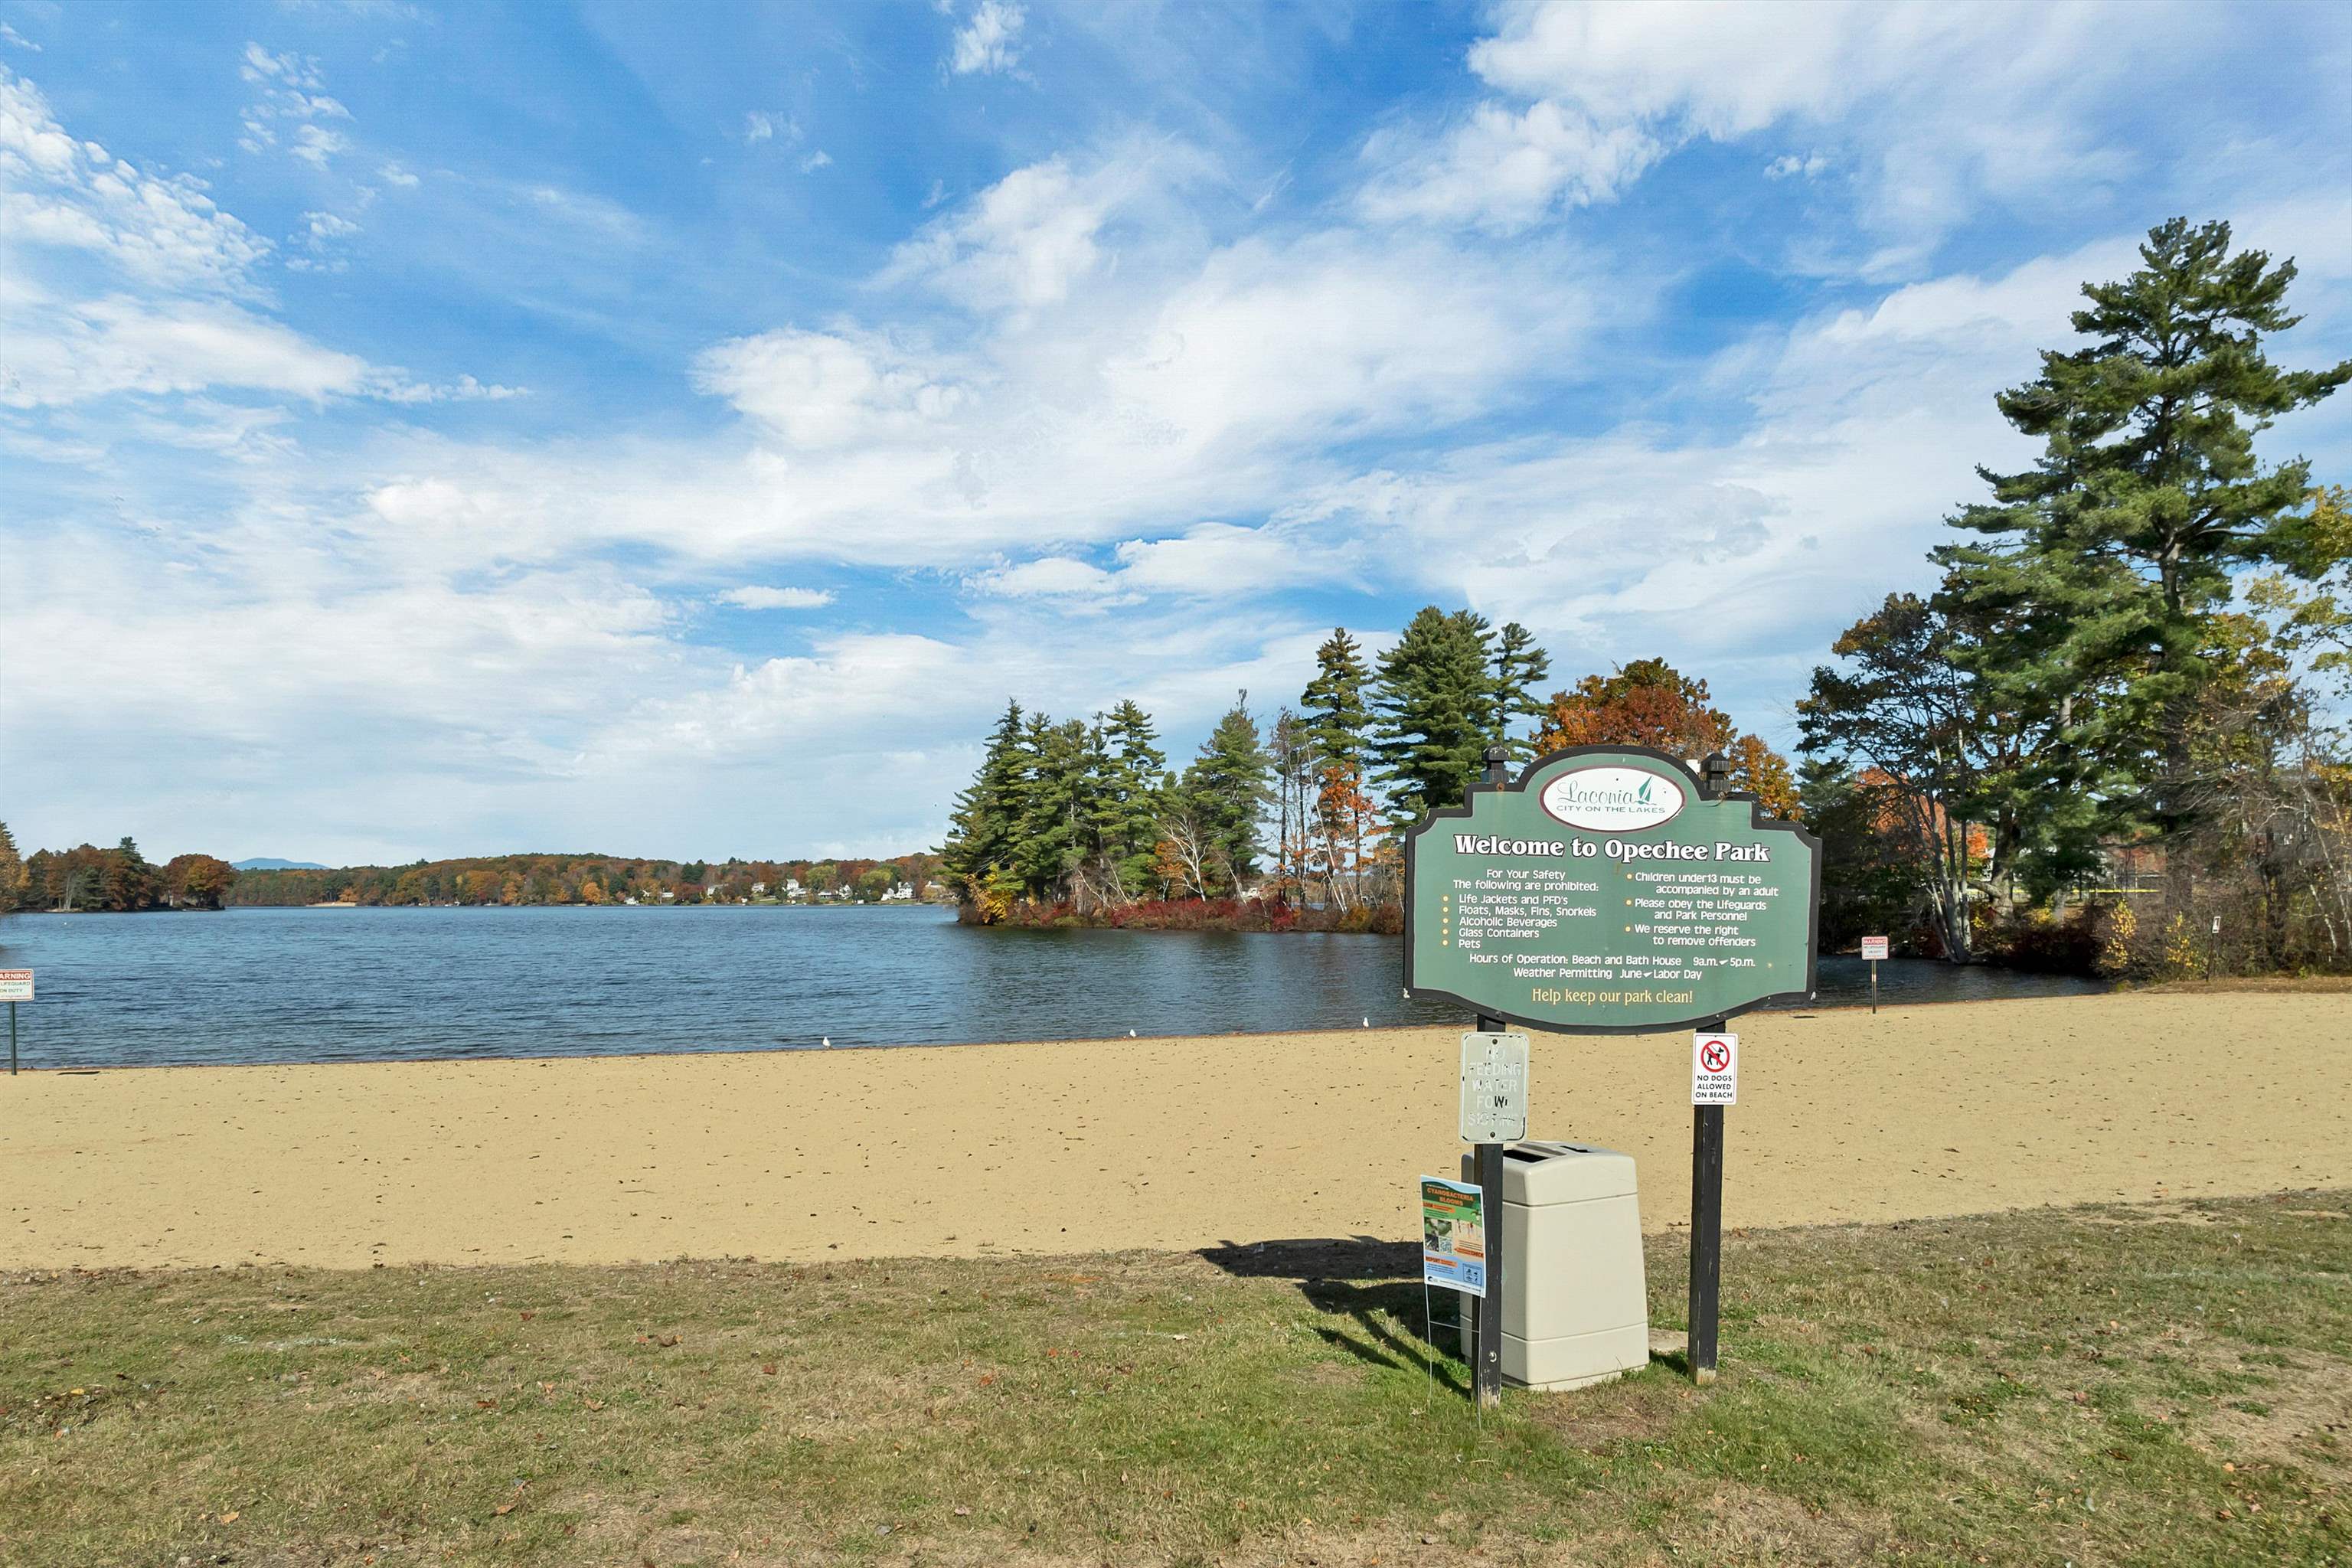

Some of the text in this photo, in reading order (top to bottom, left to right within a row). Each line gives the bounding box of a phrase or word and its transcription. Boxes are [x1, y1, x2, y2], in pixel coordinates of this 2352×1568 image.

[1557, 779, 1636, 804] Laconia
[1454, 834, 1770, 864] Welcome to Opechee Park
[1486, 869, 1566, 880] For Your Safety
[1635, 872, 1675, 882] Children
[1720, 874, 1745, 884] must
[1749, 874, 1761, 884] be
[1453, 880, 1471, 889] The
[1475, 880, 1521, 891] following
[1544, 881, 1599, 892] prohibited:
[1656, 885, 1779, 897] accompanied by an adult
[1459, 893, 1568, 905] Life Jackets and PFD's
[1635, 898, 1766, 911] Please obey the Lifeguards
[1459, 905, 1596, 917] Floats, Masks, Fins, Snorkels
[1654, 910, 1747, 921] and Park Personnel
[1459, 916, 1557, 928] Alcoholic Beverages
[1459, 928, 1540, 938] Glass Containers
[1635, 923, 1739, 936] We reserve the right
[1459, 939, 1481, 949] Pets
[1652, 936, 1756, 946] to remove offenders
[1469, 953, 1498, 963] Hours
[1501, 954, 1513, 963] of
[1517, 954, 1568, 965] Operation:
[1572, 955, 1601, 965] Beach
[1604, 956, 1622, 965] and
[1625, 956, 1649, 965] Bath
[1652, 956, 1681, 965] House
[1513, 967, 1556, 978] Weather
[1559, 968, 1612, 979] Permitting
[1684, 970, 1702, 980] Day
[1532, 988, 1693, 1006] Help keep our park clean!
[1470, 1063, 1521, 1076] FEEDING
[1472, 1079, 1517, 1093] WATER
